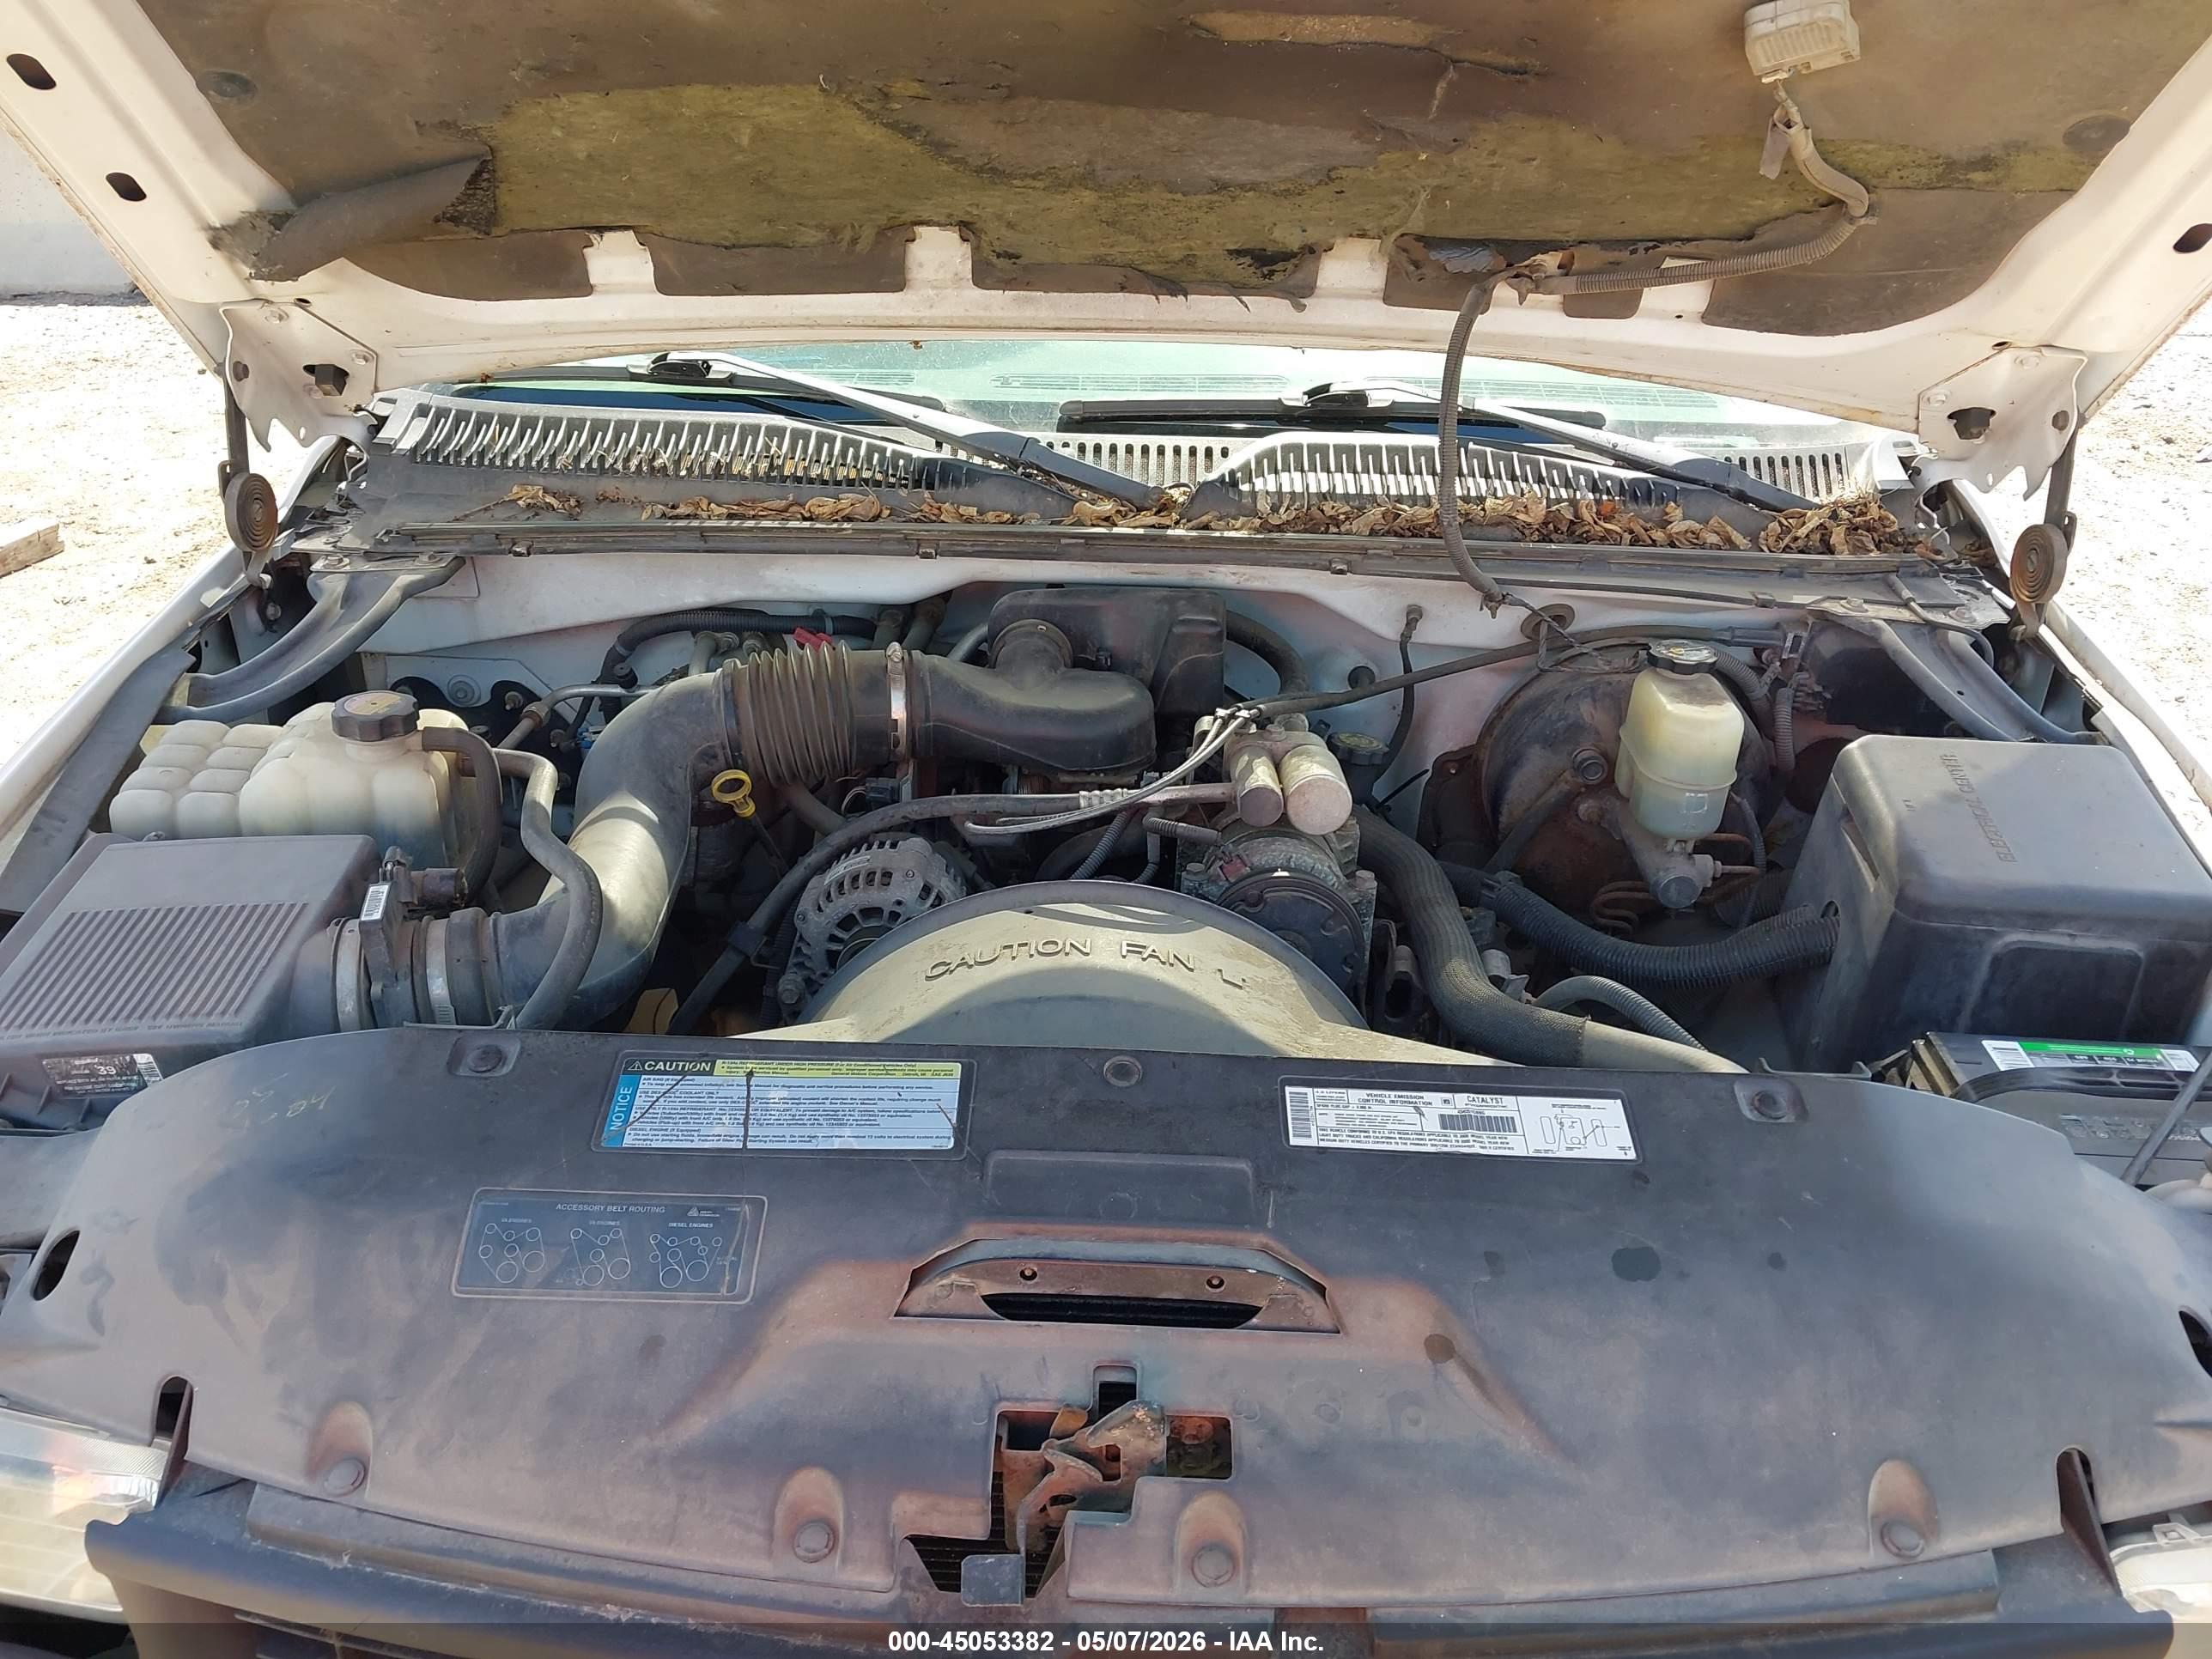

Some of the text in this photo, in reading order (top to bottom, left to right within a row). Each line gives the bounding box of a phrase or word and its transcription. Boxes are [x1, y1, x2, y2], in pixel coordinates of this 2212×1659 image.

[1940, 753, 1975, 793] CENTER
[925, 937, 1091, 981] CAUTION
[1121, 940, 1195, 972] FAN
[644, 1060, 712, 1072] CAUTION
[610, 1086, 633, 1131] NOTICE
